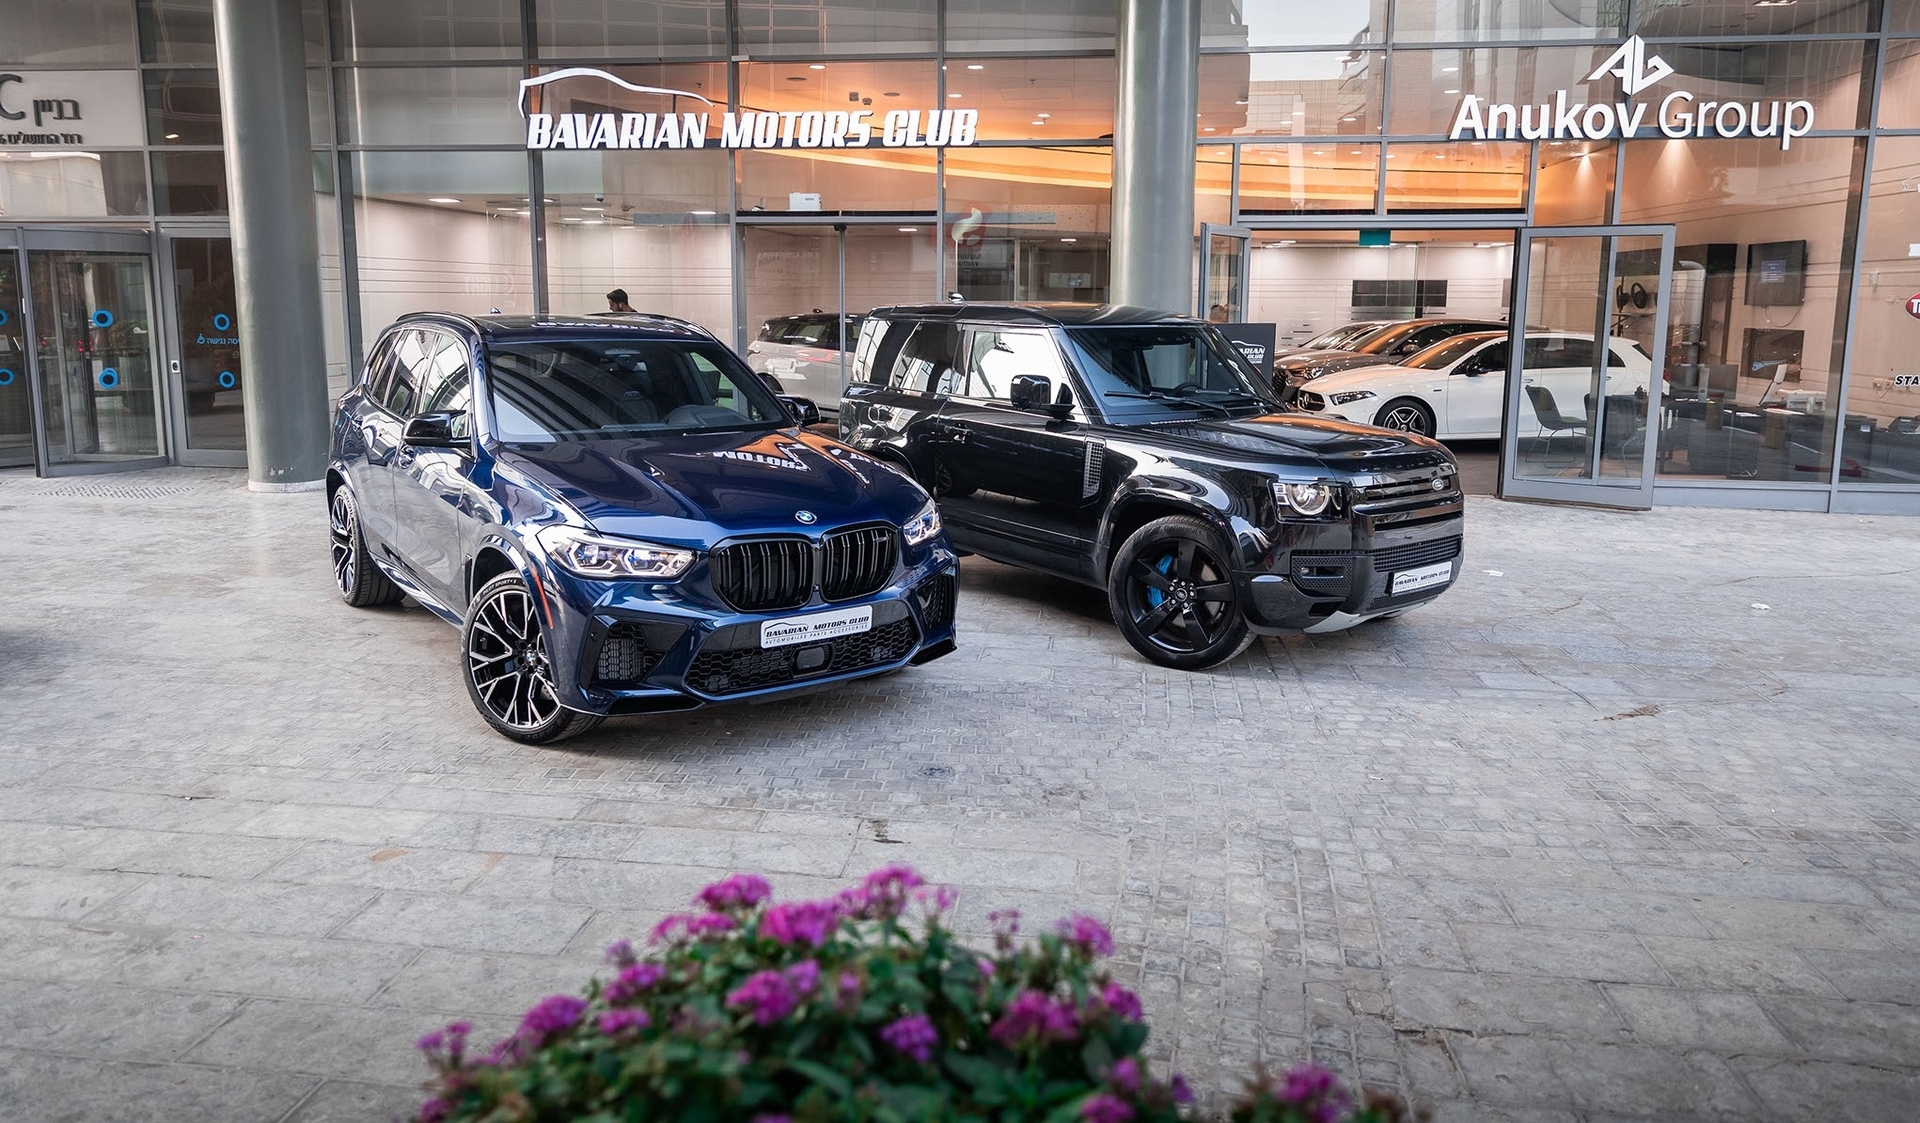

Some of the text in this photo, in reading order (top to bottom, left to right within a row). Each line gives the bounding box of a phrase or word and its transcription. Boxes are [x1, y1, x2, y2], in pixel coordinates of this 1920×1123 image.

[526, 108, 979, 149] BAVARIAN MOTORS CLUB
[1450, 89, 1815, 151] Anukov Group
[766, 616, 869, 637] BAVARIAN MOTORS CLUB
